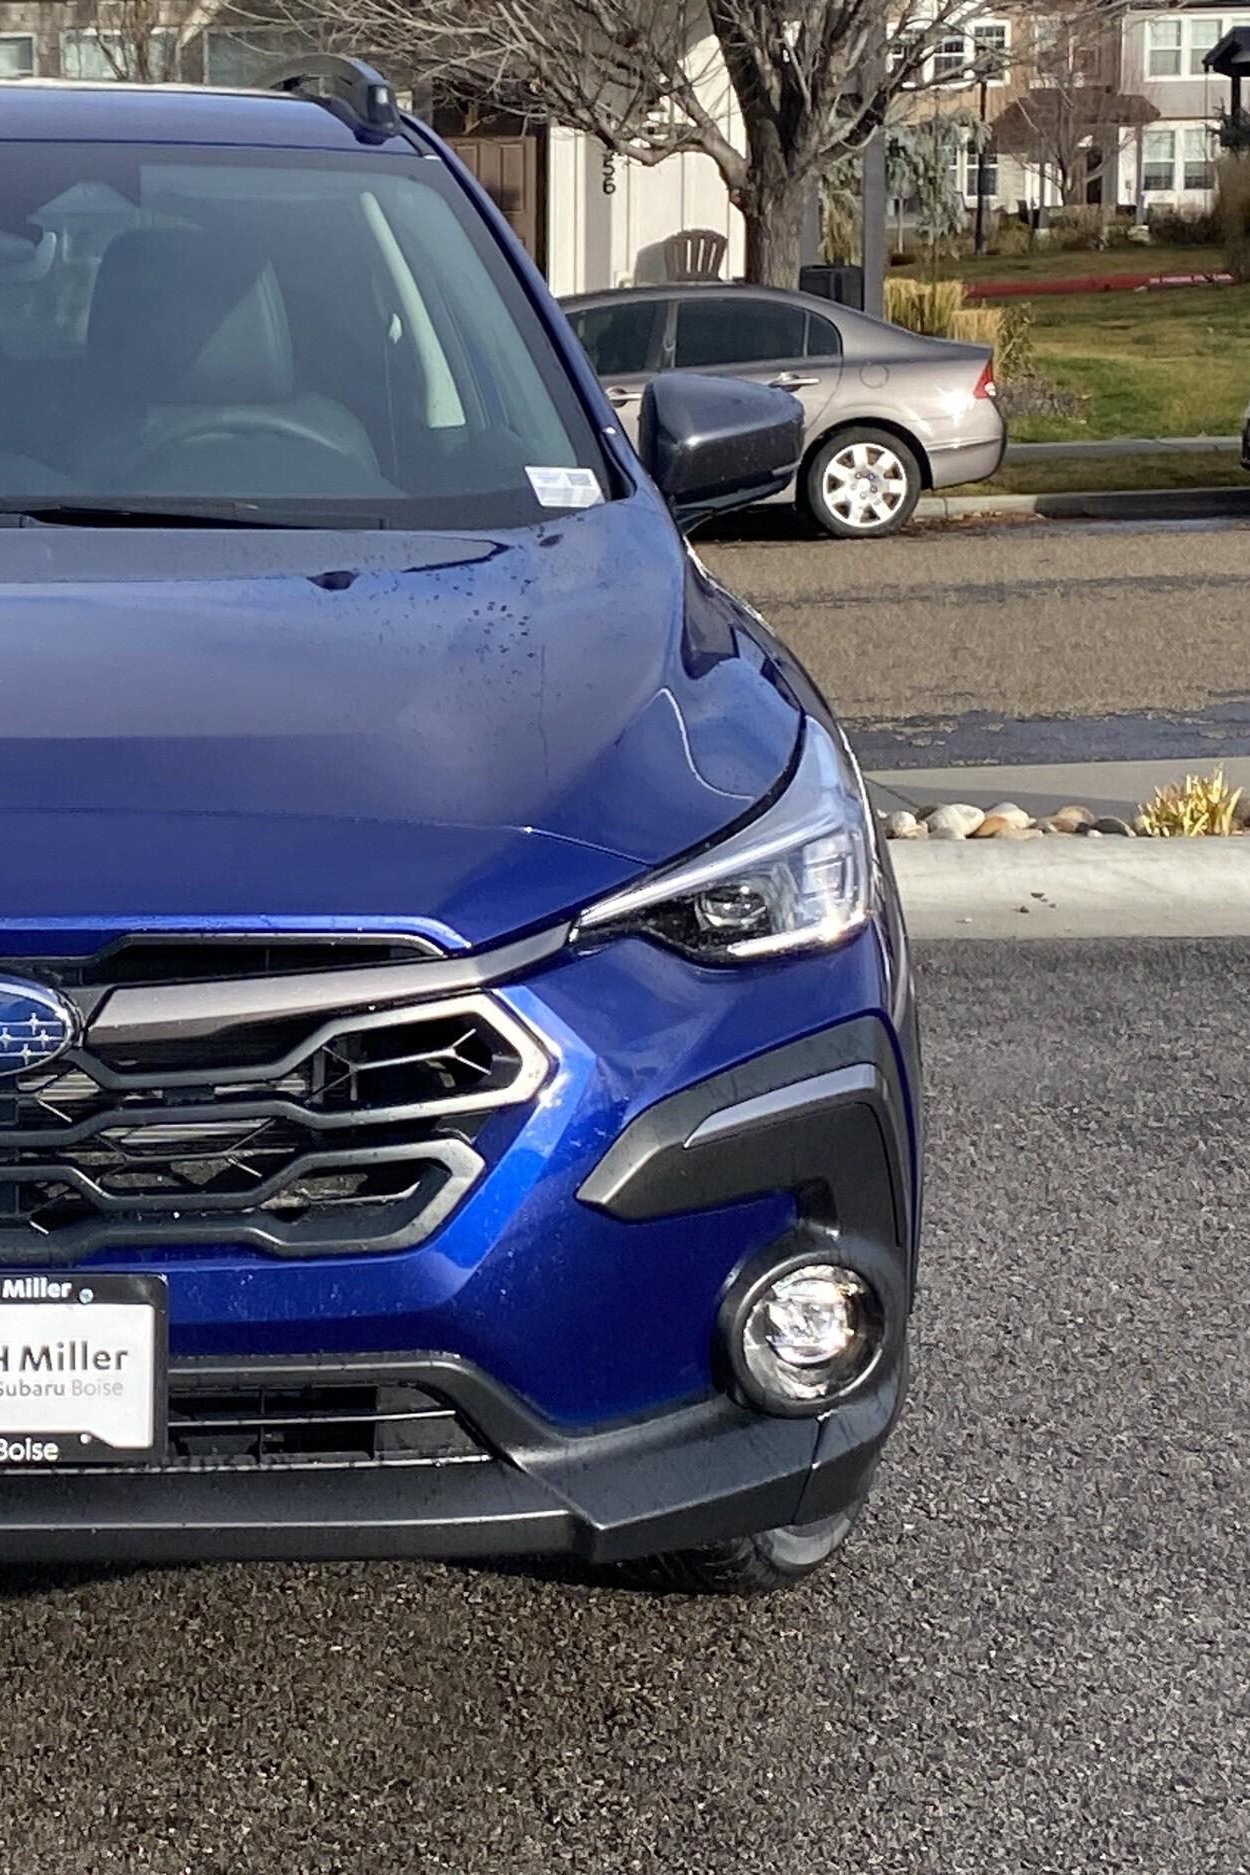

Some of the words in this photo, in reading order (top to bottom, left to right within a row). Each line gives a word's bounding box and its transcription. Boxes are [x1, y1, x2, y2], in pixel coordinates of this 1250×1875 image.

[2, 1276, 73, 1299] Miller
[18, 1340, 129, 1373] Miller
[71, 1378, 124, 1397] Boise
